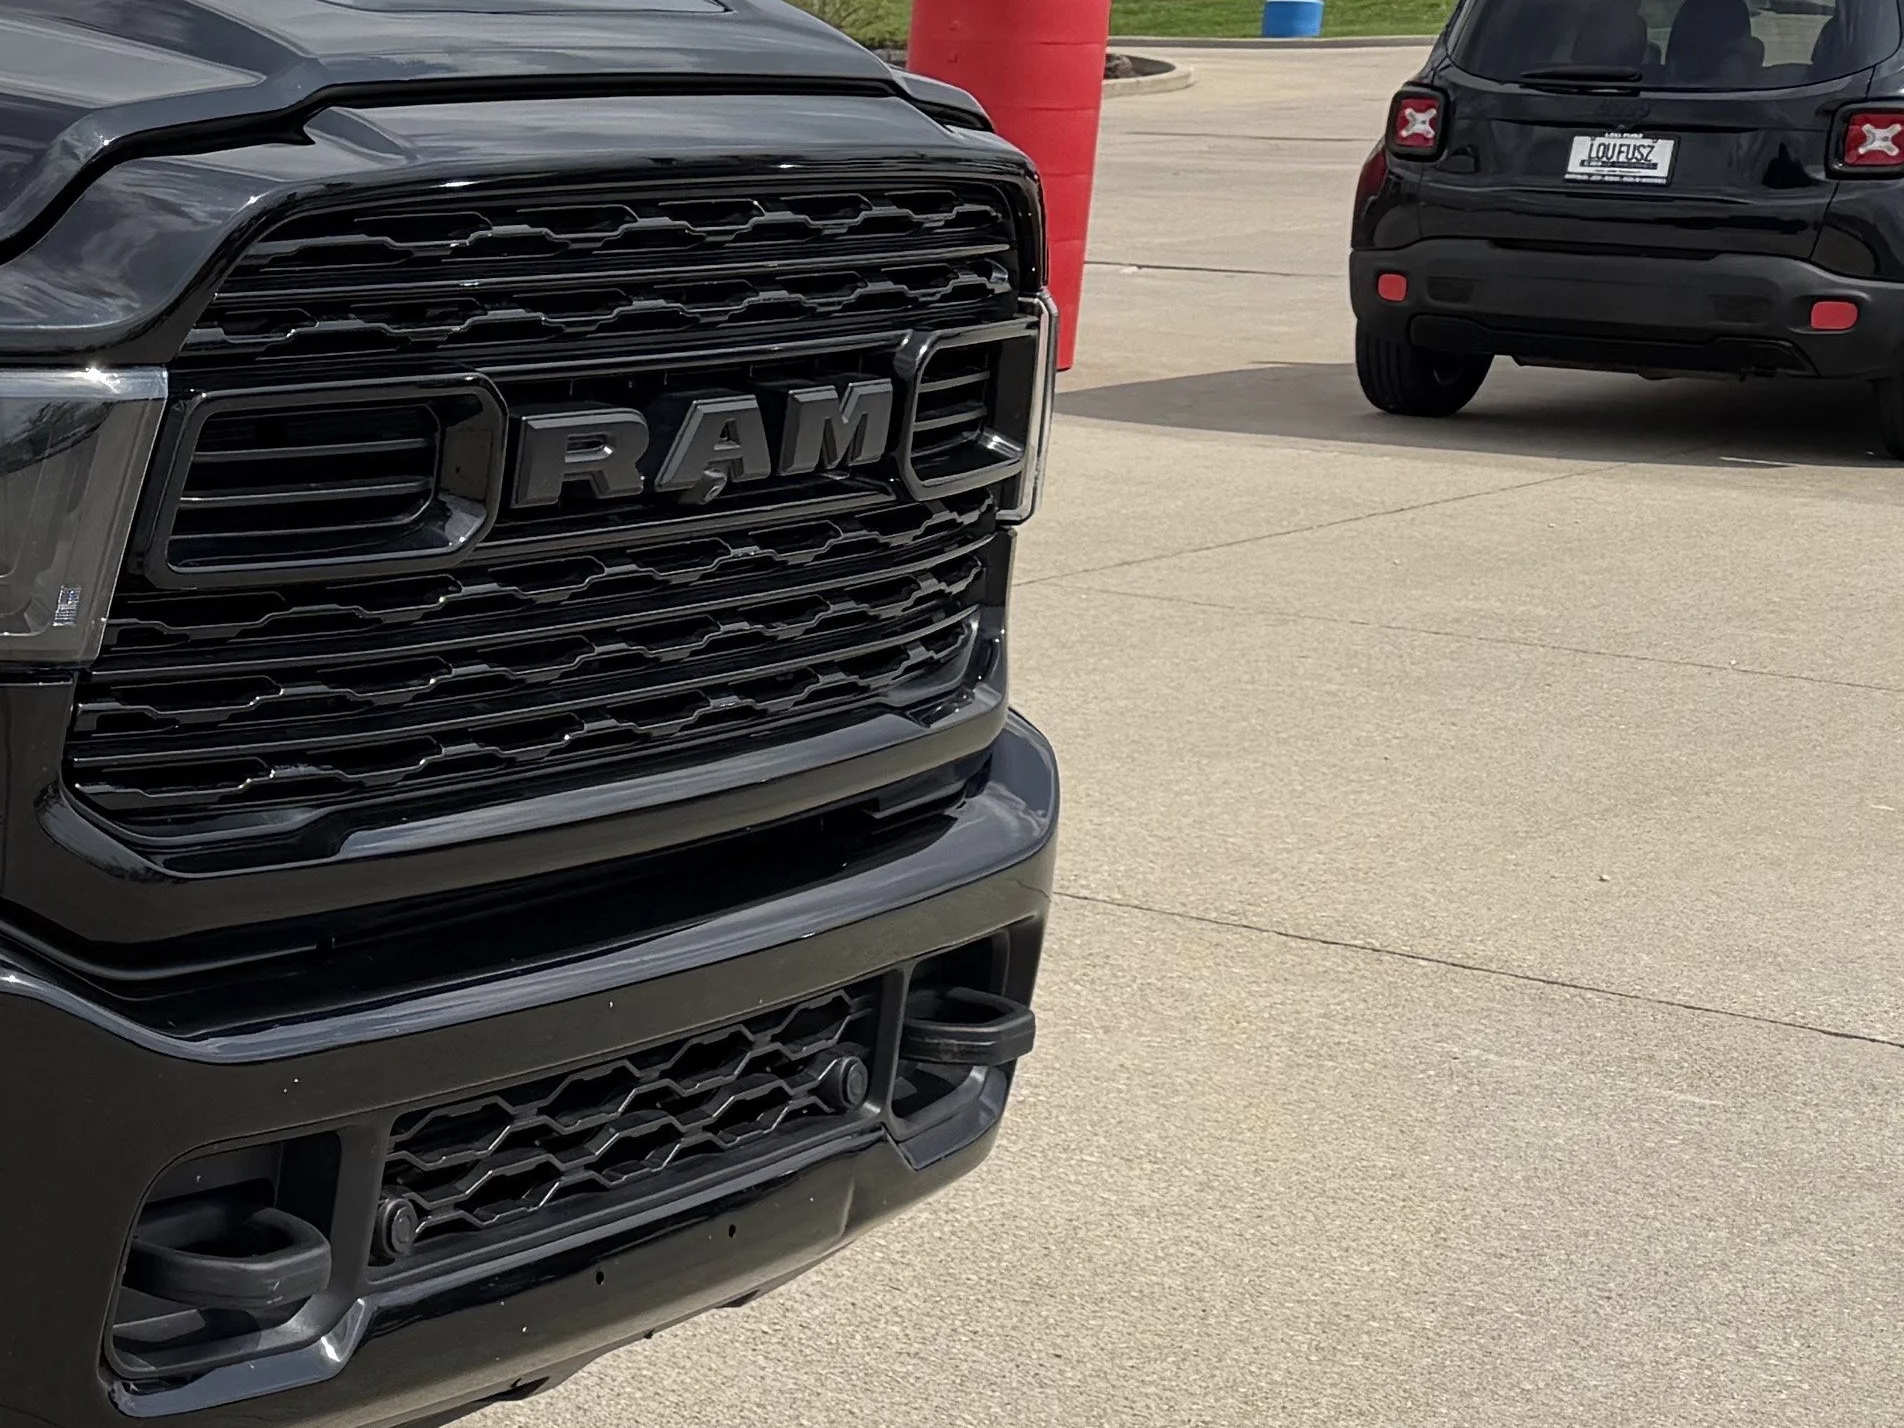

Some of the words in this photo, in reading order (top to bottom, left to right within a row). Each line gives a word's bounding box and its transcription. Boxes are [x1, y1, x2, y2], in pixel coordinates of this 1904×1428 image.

[1588, 142, 1616, 160] LOU
[1616, 143, 1655, 162] FUSZ
[510, 377, 893, 509] RAM
